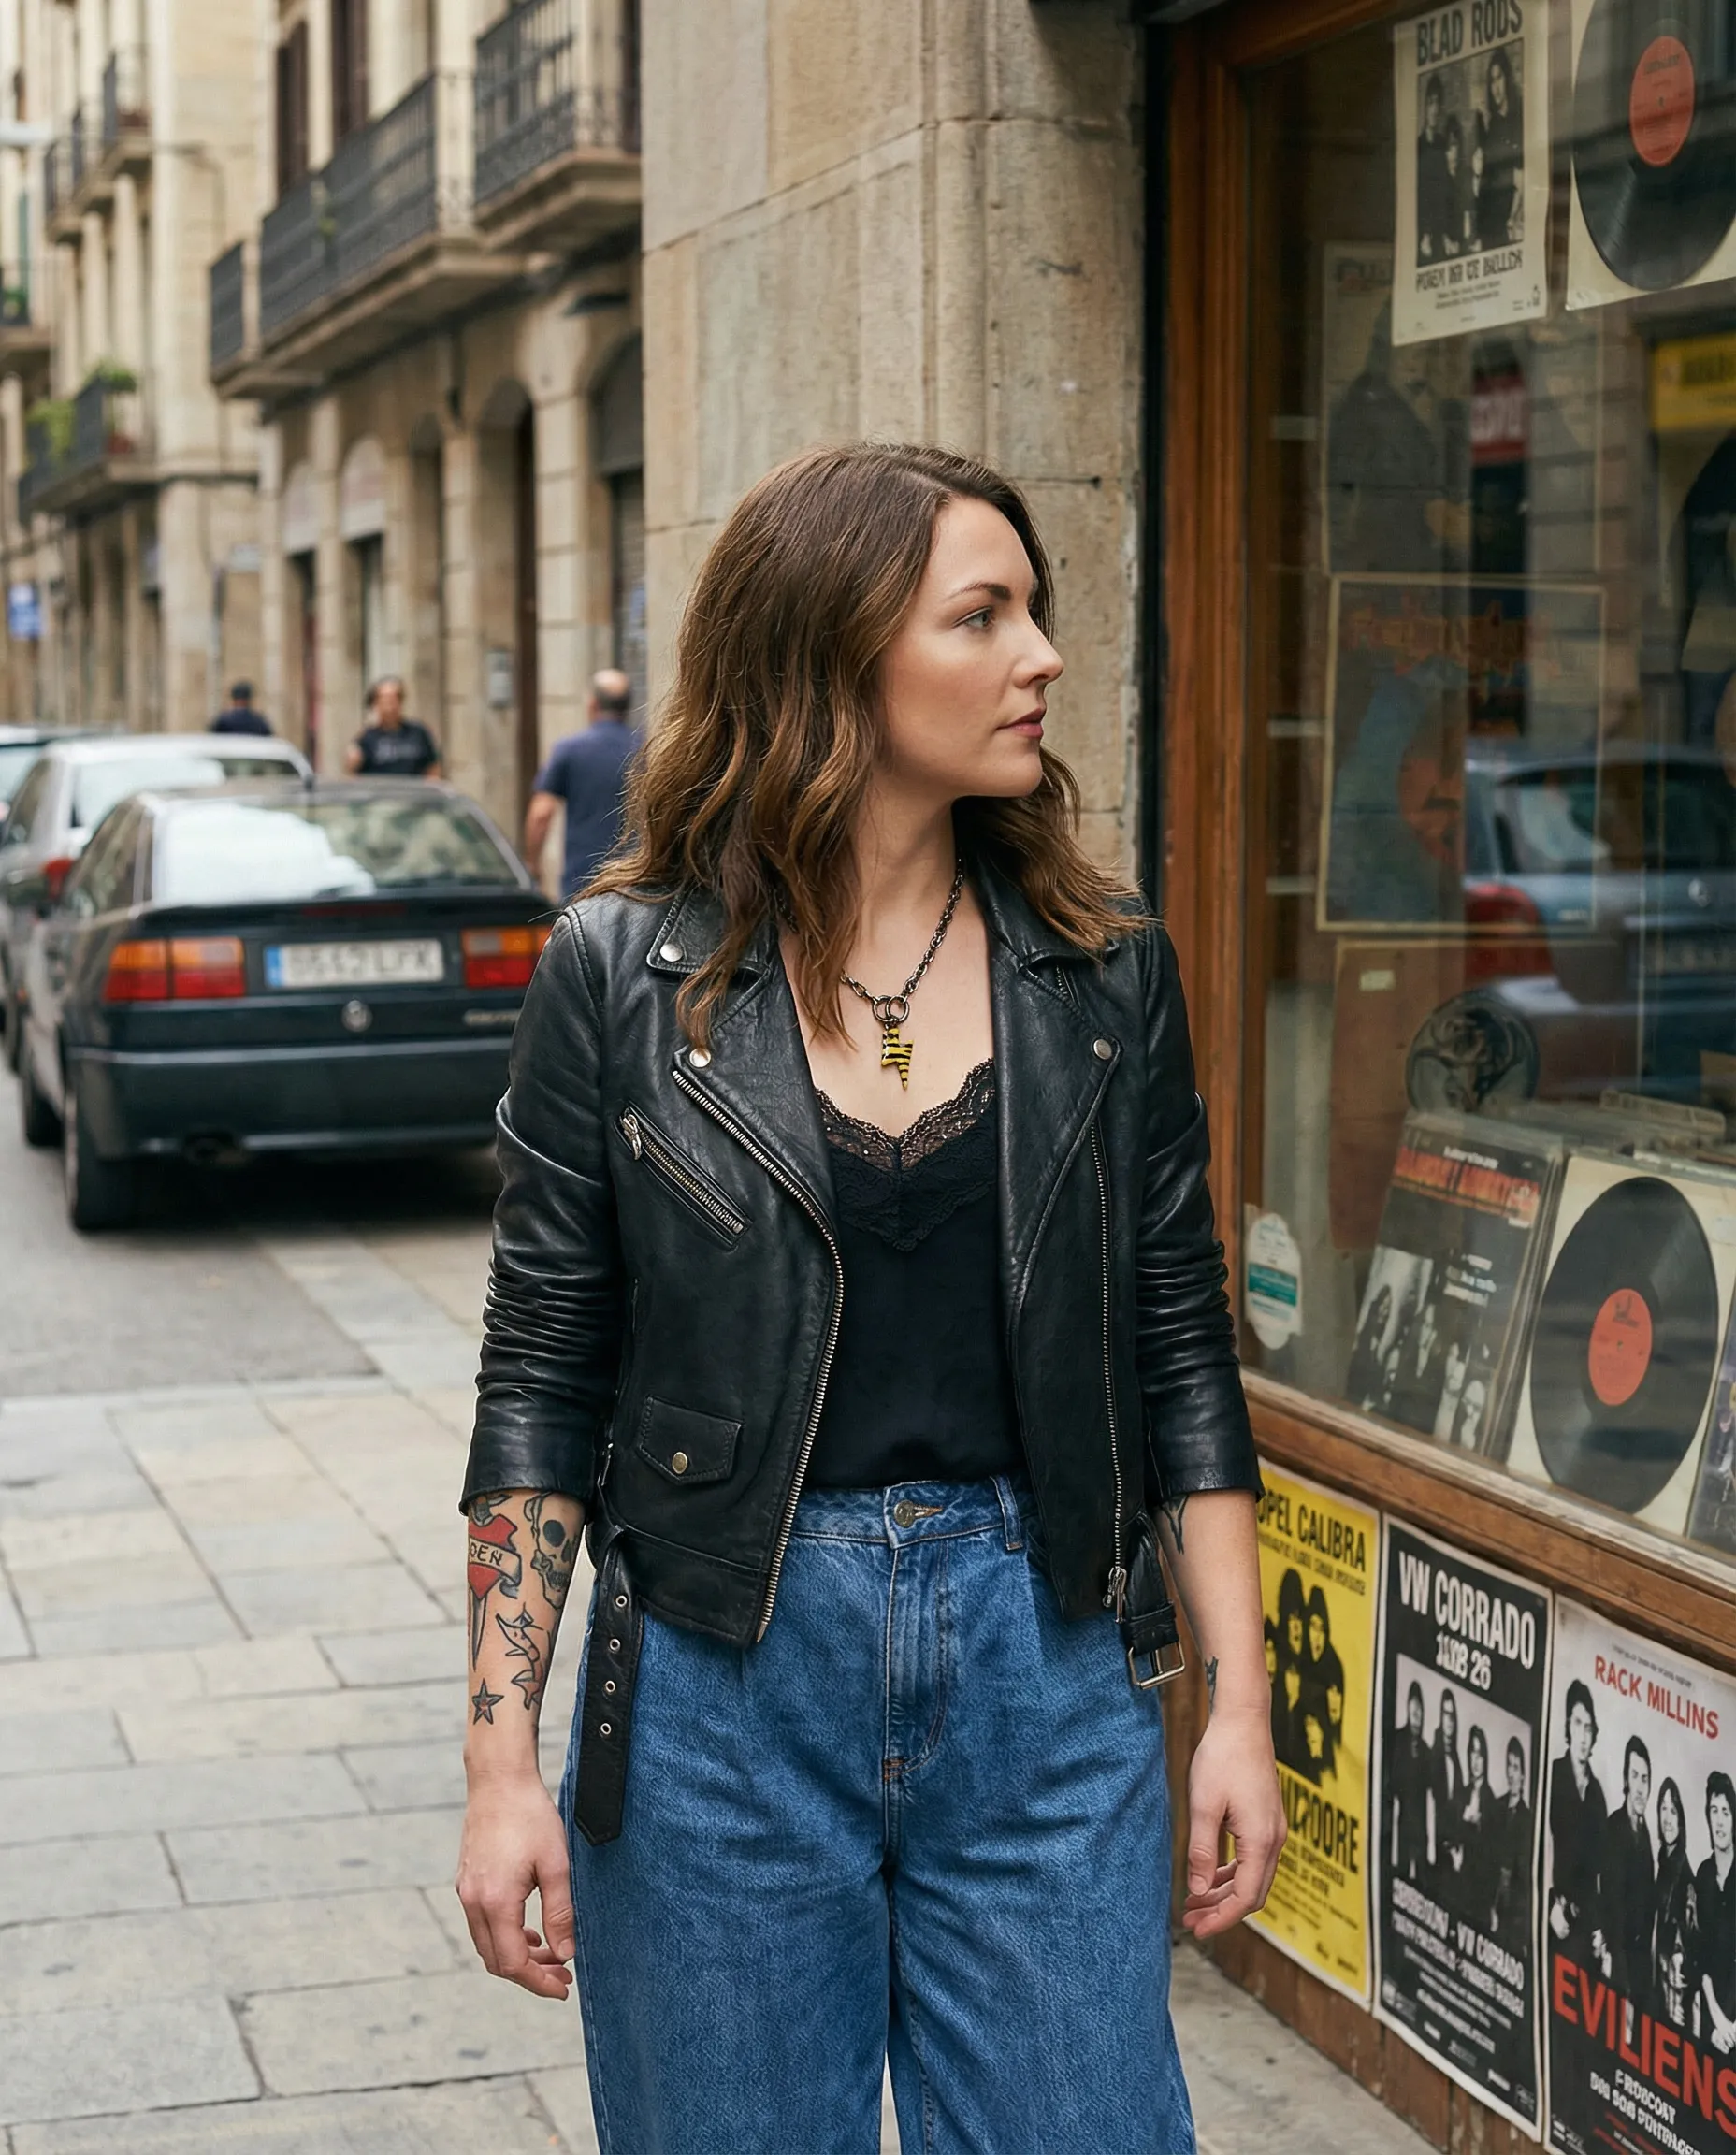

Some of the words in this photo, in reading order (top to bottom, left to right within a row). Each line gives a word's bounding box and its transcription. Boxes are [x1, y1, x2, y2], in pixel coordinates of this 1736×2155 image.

[1297, 1504, 1366, 1572] CALIBRA
[1399, 1550, 1430, 1615] VW
[1434, 1569, 1535, 1670] CORRADO
[1469, 1649, 1492, 1690] 26
[1595, 1654, 1642, 1702] RACK
[1647, 1681, 1719, 1740] MILLINS
[1554, 1952, 1736, 2139] EVILIENS
